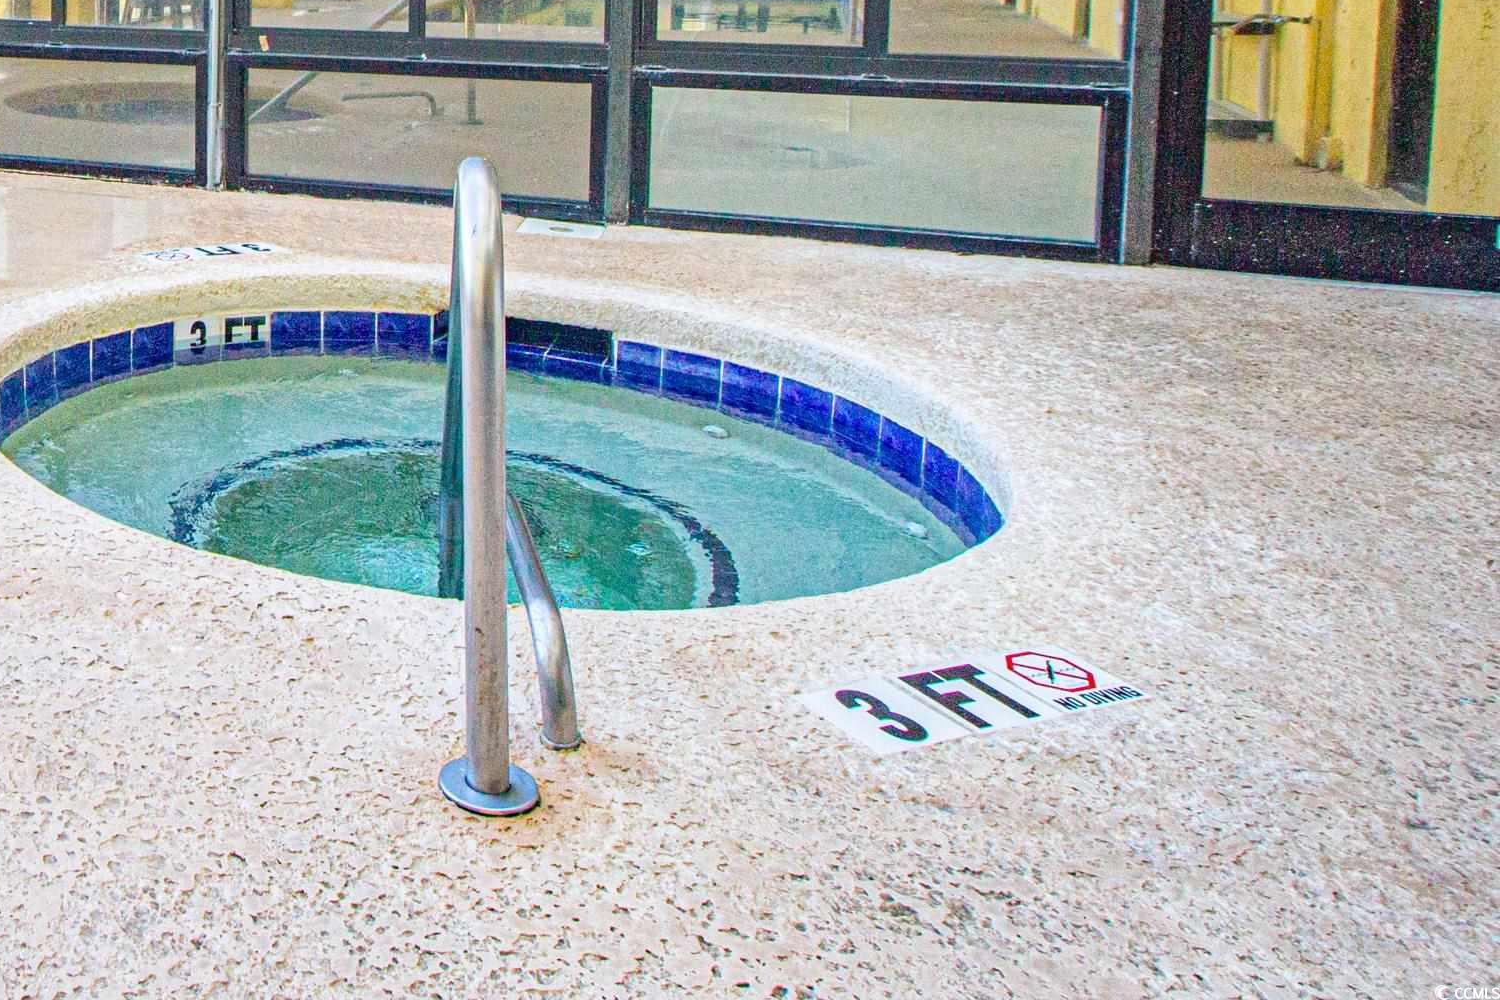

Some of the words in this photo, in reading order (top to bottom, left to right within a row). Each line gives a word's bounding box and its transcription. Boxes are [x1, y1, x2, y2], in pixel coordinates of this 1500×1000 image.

[190, 320, 207, 352] 3
[224, 316, 266, 343] FT
[835, 689, 928, 742] 3
[897, 663, 1041, 728] FT
[1053, 696, 1087, 710] NO
[1079, 685, 1144, 705] DIVING
